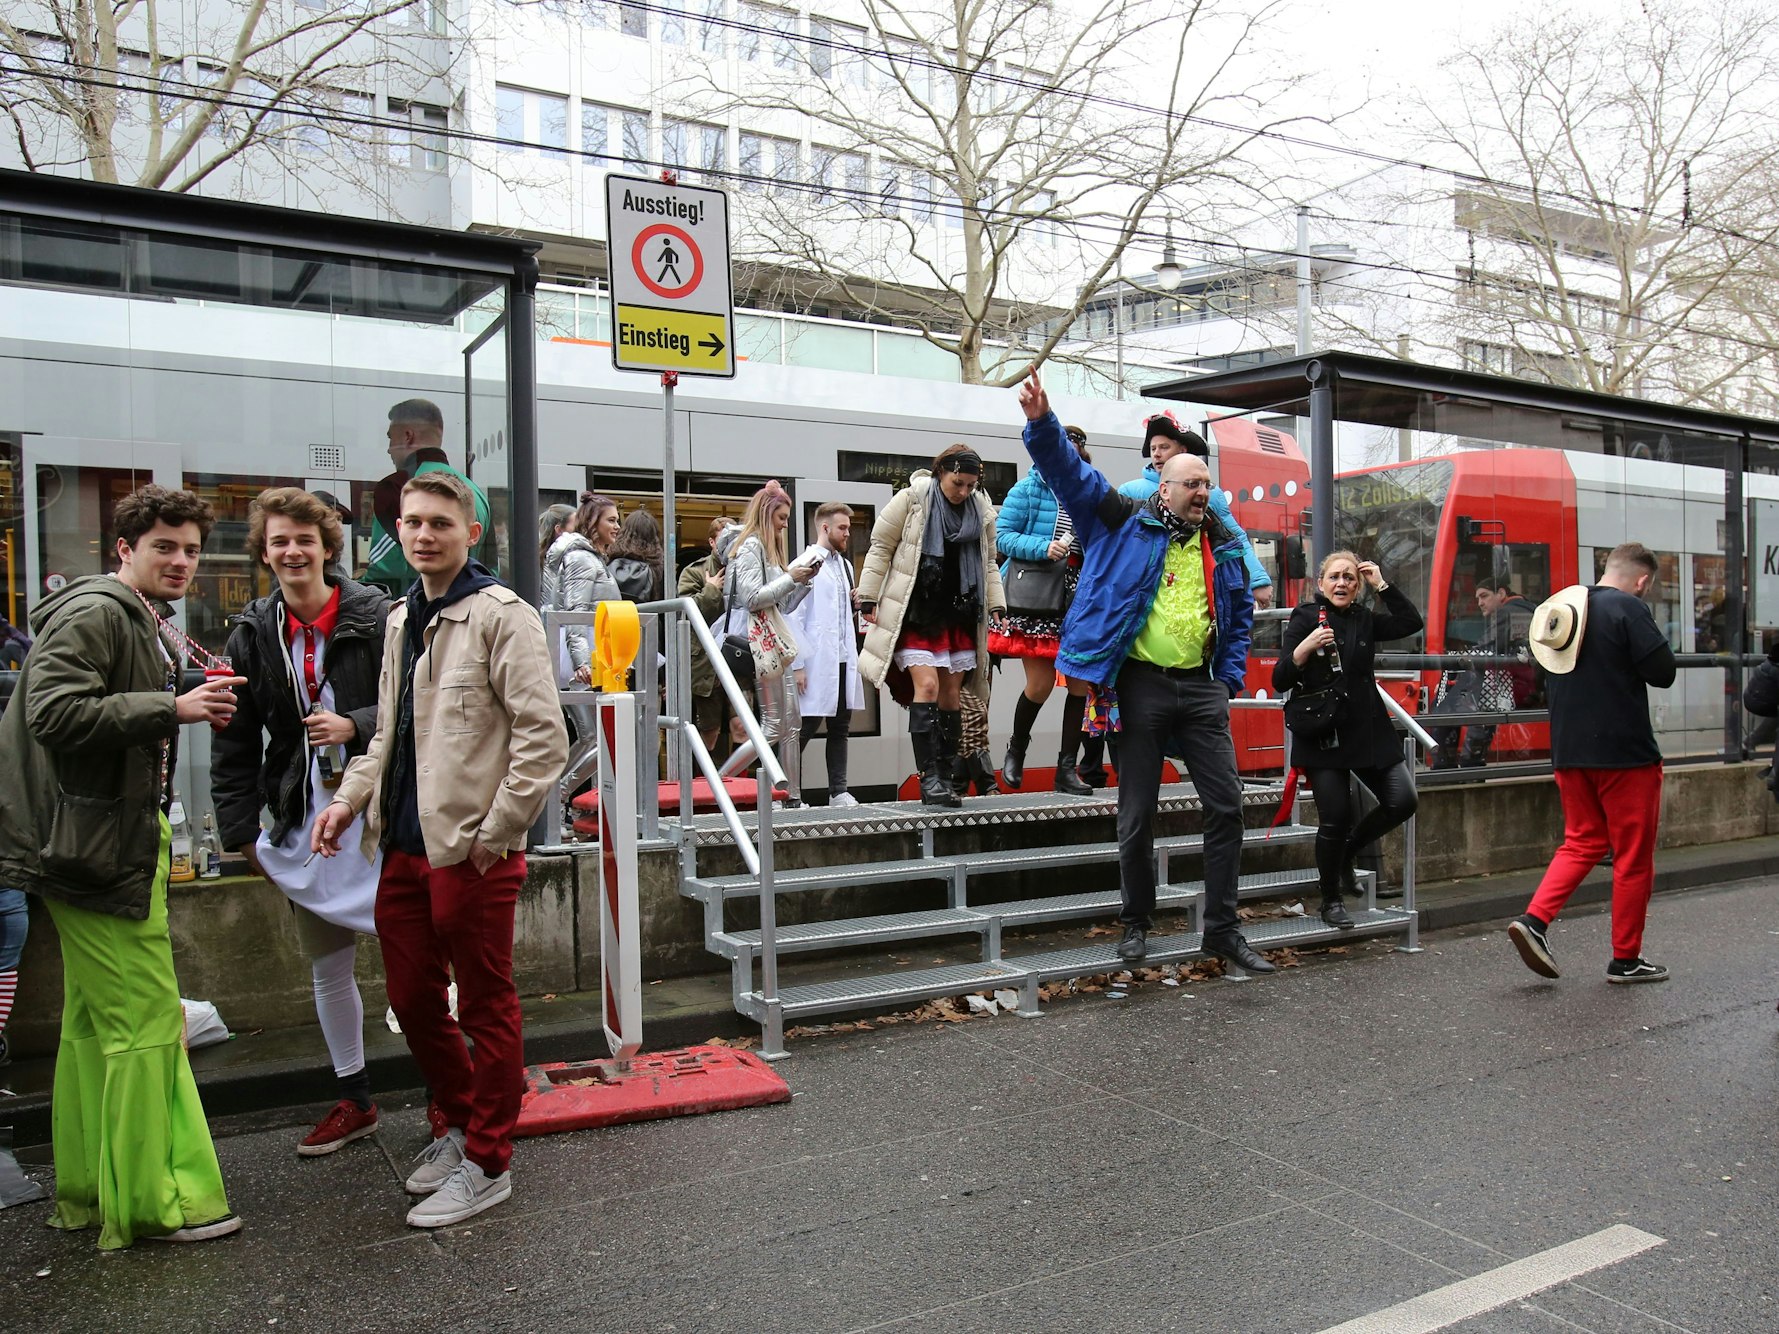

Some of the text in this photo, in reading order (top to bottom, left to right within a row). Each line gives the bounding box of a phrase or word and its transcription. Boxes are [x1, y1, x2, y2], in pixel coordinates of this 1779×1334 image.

[622, 188, 704, 226] Ausstieg!
[619, 322, 690, 357] Einstieg
[1764, 545, 1779, 575] K
